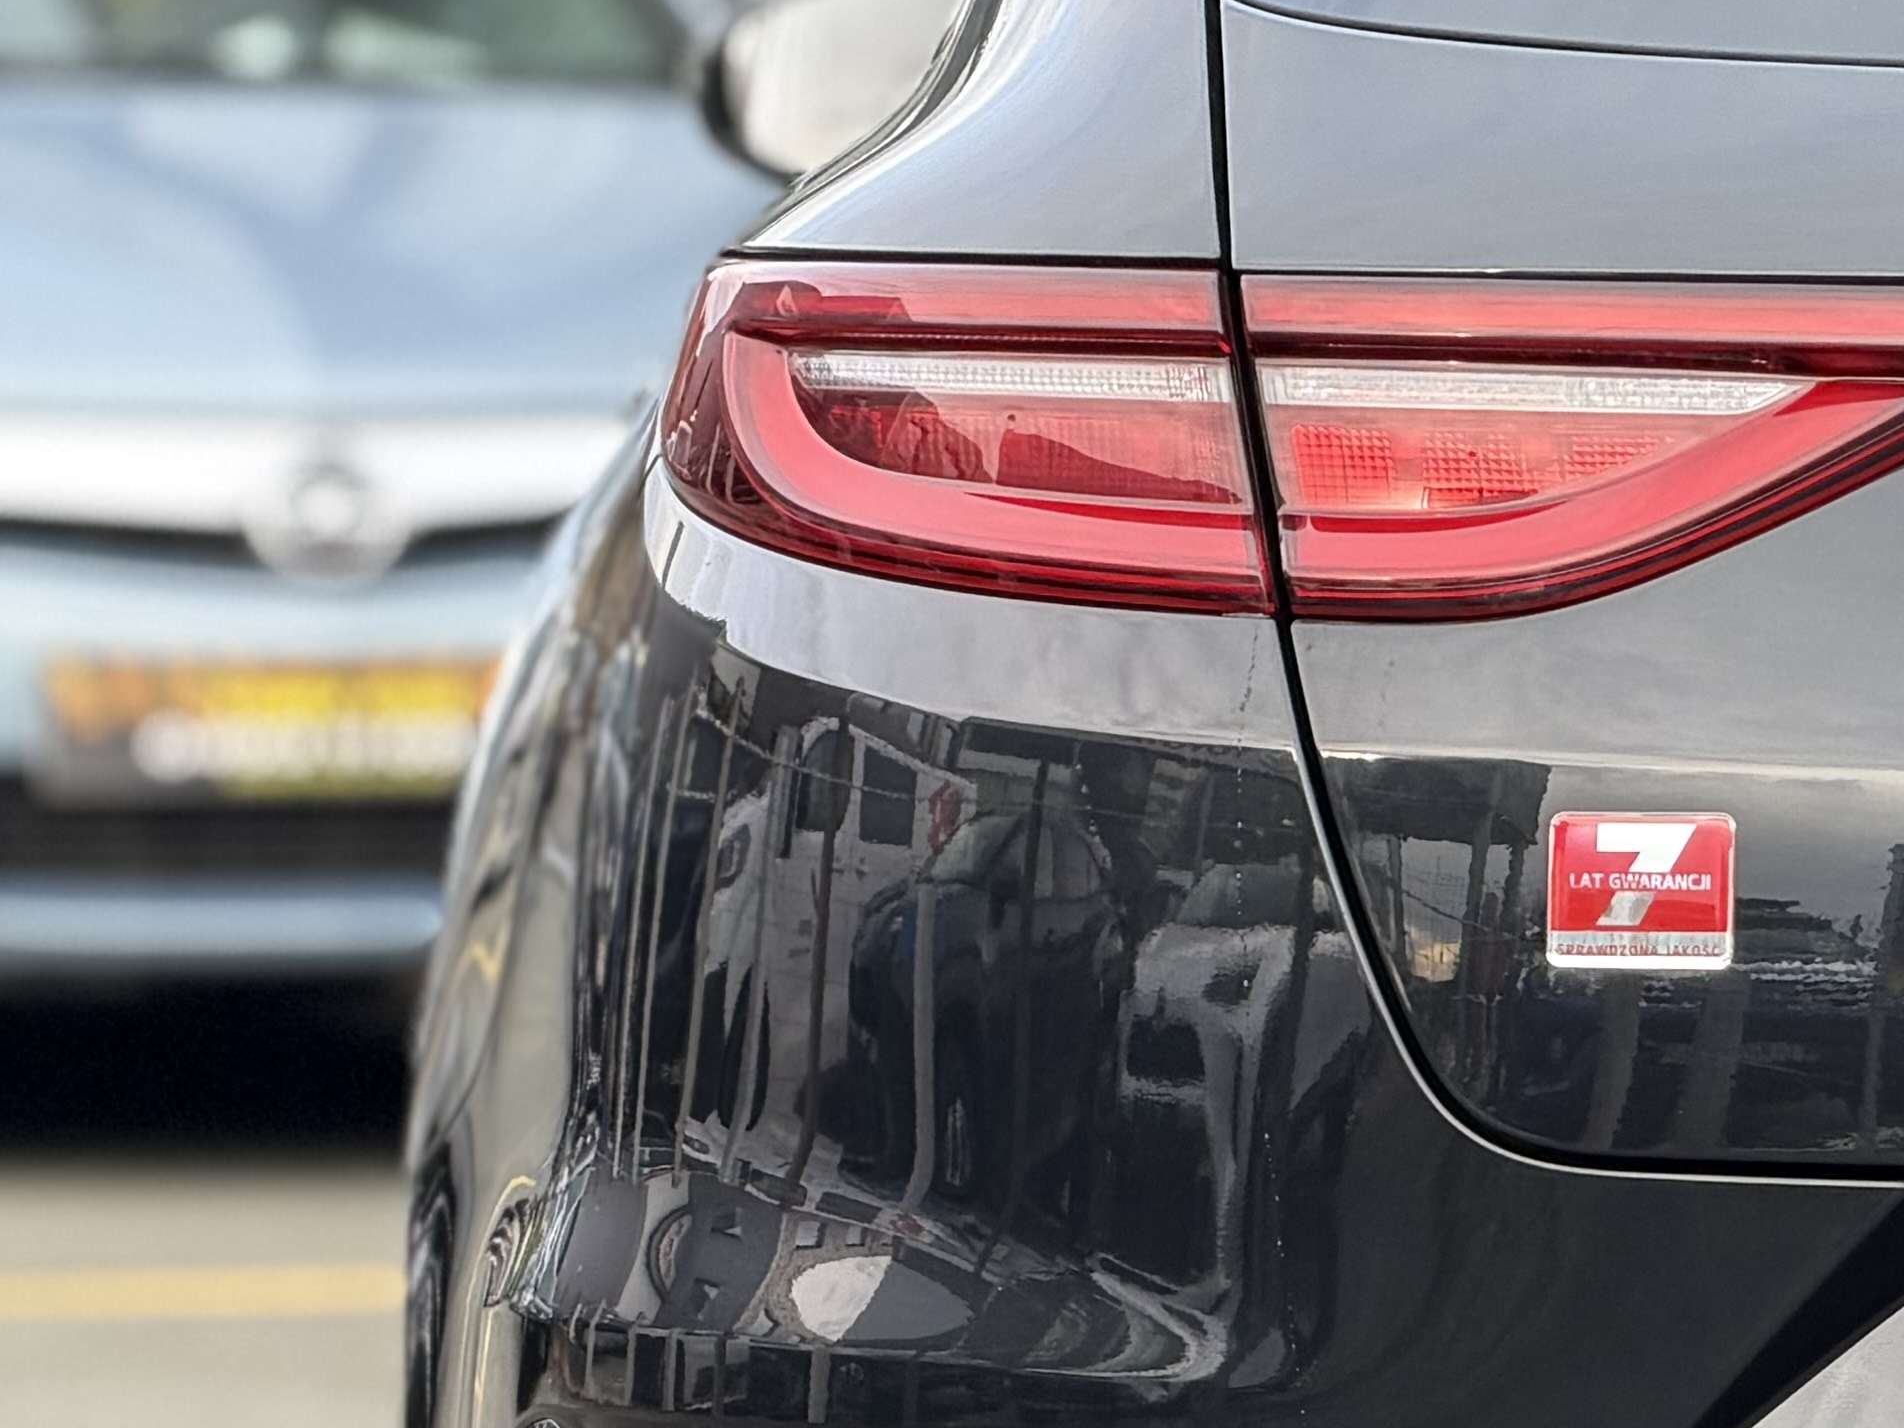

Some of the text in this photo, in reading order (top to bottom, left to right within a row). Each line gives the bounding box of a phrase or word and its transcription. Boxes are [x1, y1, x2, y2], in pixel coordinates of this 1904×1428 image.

[1569, 873, 1712, 891] LAT GWARANCJI
[1595, 822, 1698, 927] 7
